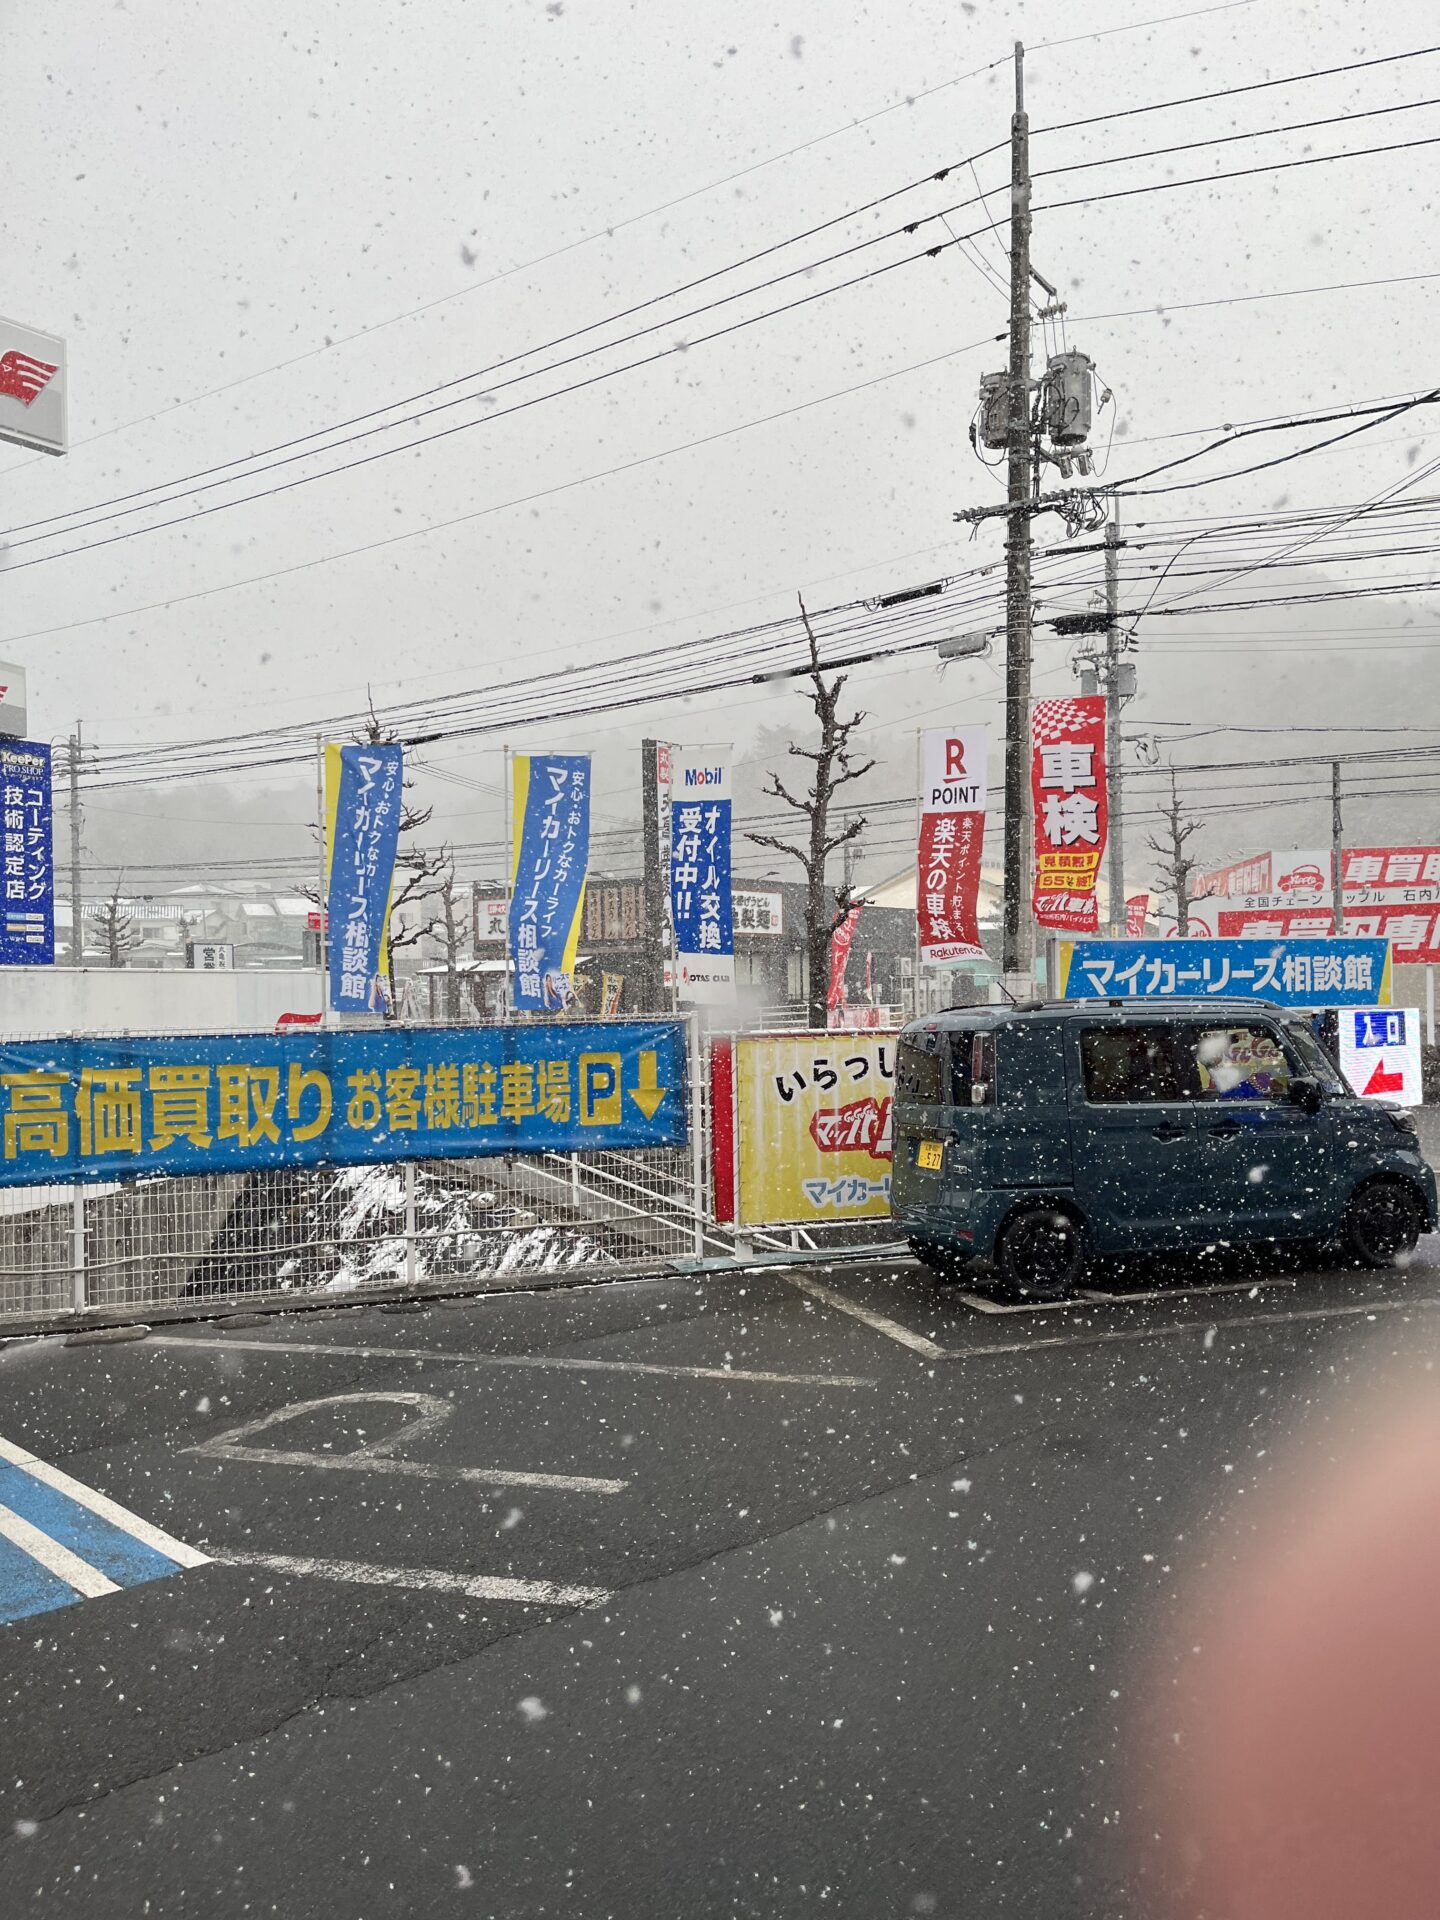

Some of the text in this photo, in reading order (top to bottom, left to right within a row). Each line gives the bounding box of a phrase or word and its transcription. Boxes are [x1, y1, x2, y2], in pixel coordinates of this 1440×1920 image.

[2, 750, 45, 767] KeePer
[4, 764, 44, 776] PRO SHOP
[685, 768, 722, 786] Mobil
[945, 738, 967, 776] R
[931, 786, 980, 805] POINT
[1040, 741, 1100, 846] 車検
[4, 785, 25, 899] 技術認定店
[27, 789, 46, 900] コーティング
[541, 771, 585, 938] 安心・おトクなカーライフ
[340, 756, 382, 999] マイカーリース相談館
[518, 766, 568, 998] マイカーリース相談館
[699, 805, 721, 950] オイル交換
[925, 818, 956, 940] 楽天の車検
[1244, 894, 1323, 909] 全国チェーン
[1345, 891, 1385, 904] ップル
[929, 946, 970, 959] Rakuten
[1083, 955, 1373, 995] マイカーリース相談館
[1363, 1015, 1400, 1046] 入口
[0, 1060, 616, 1160] 高価買取り お客様駐車場 P
